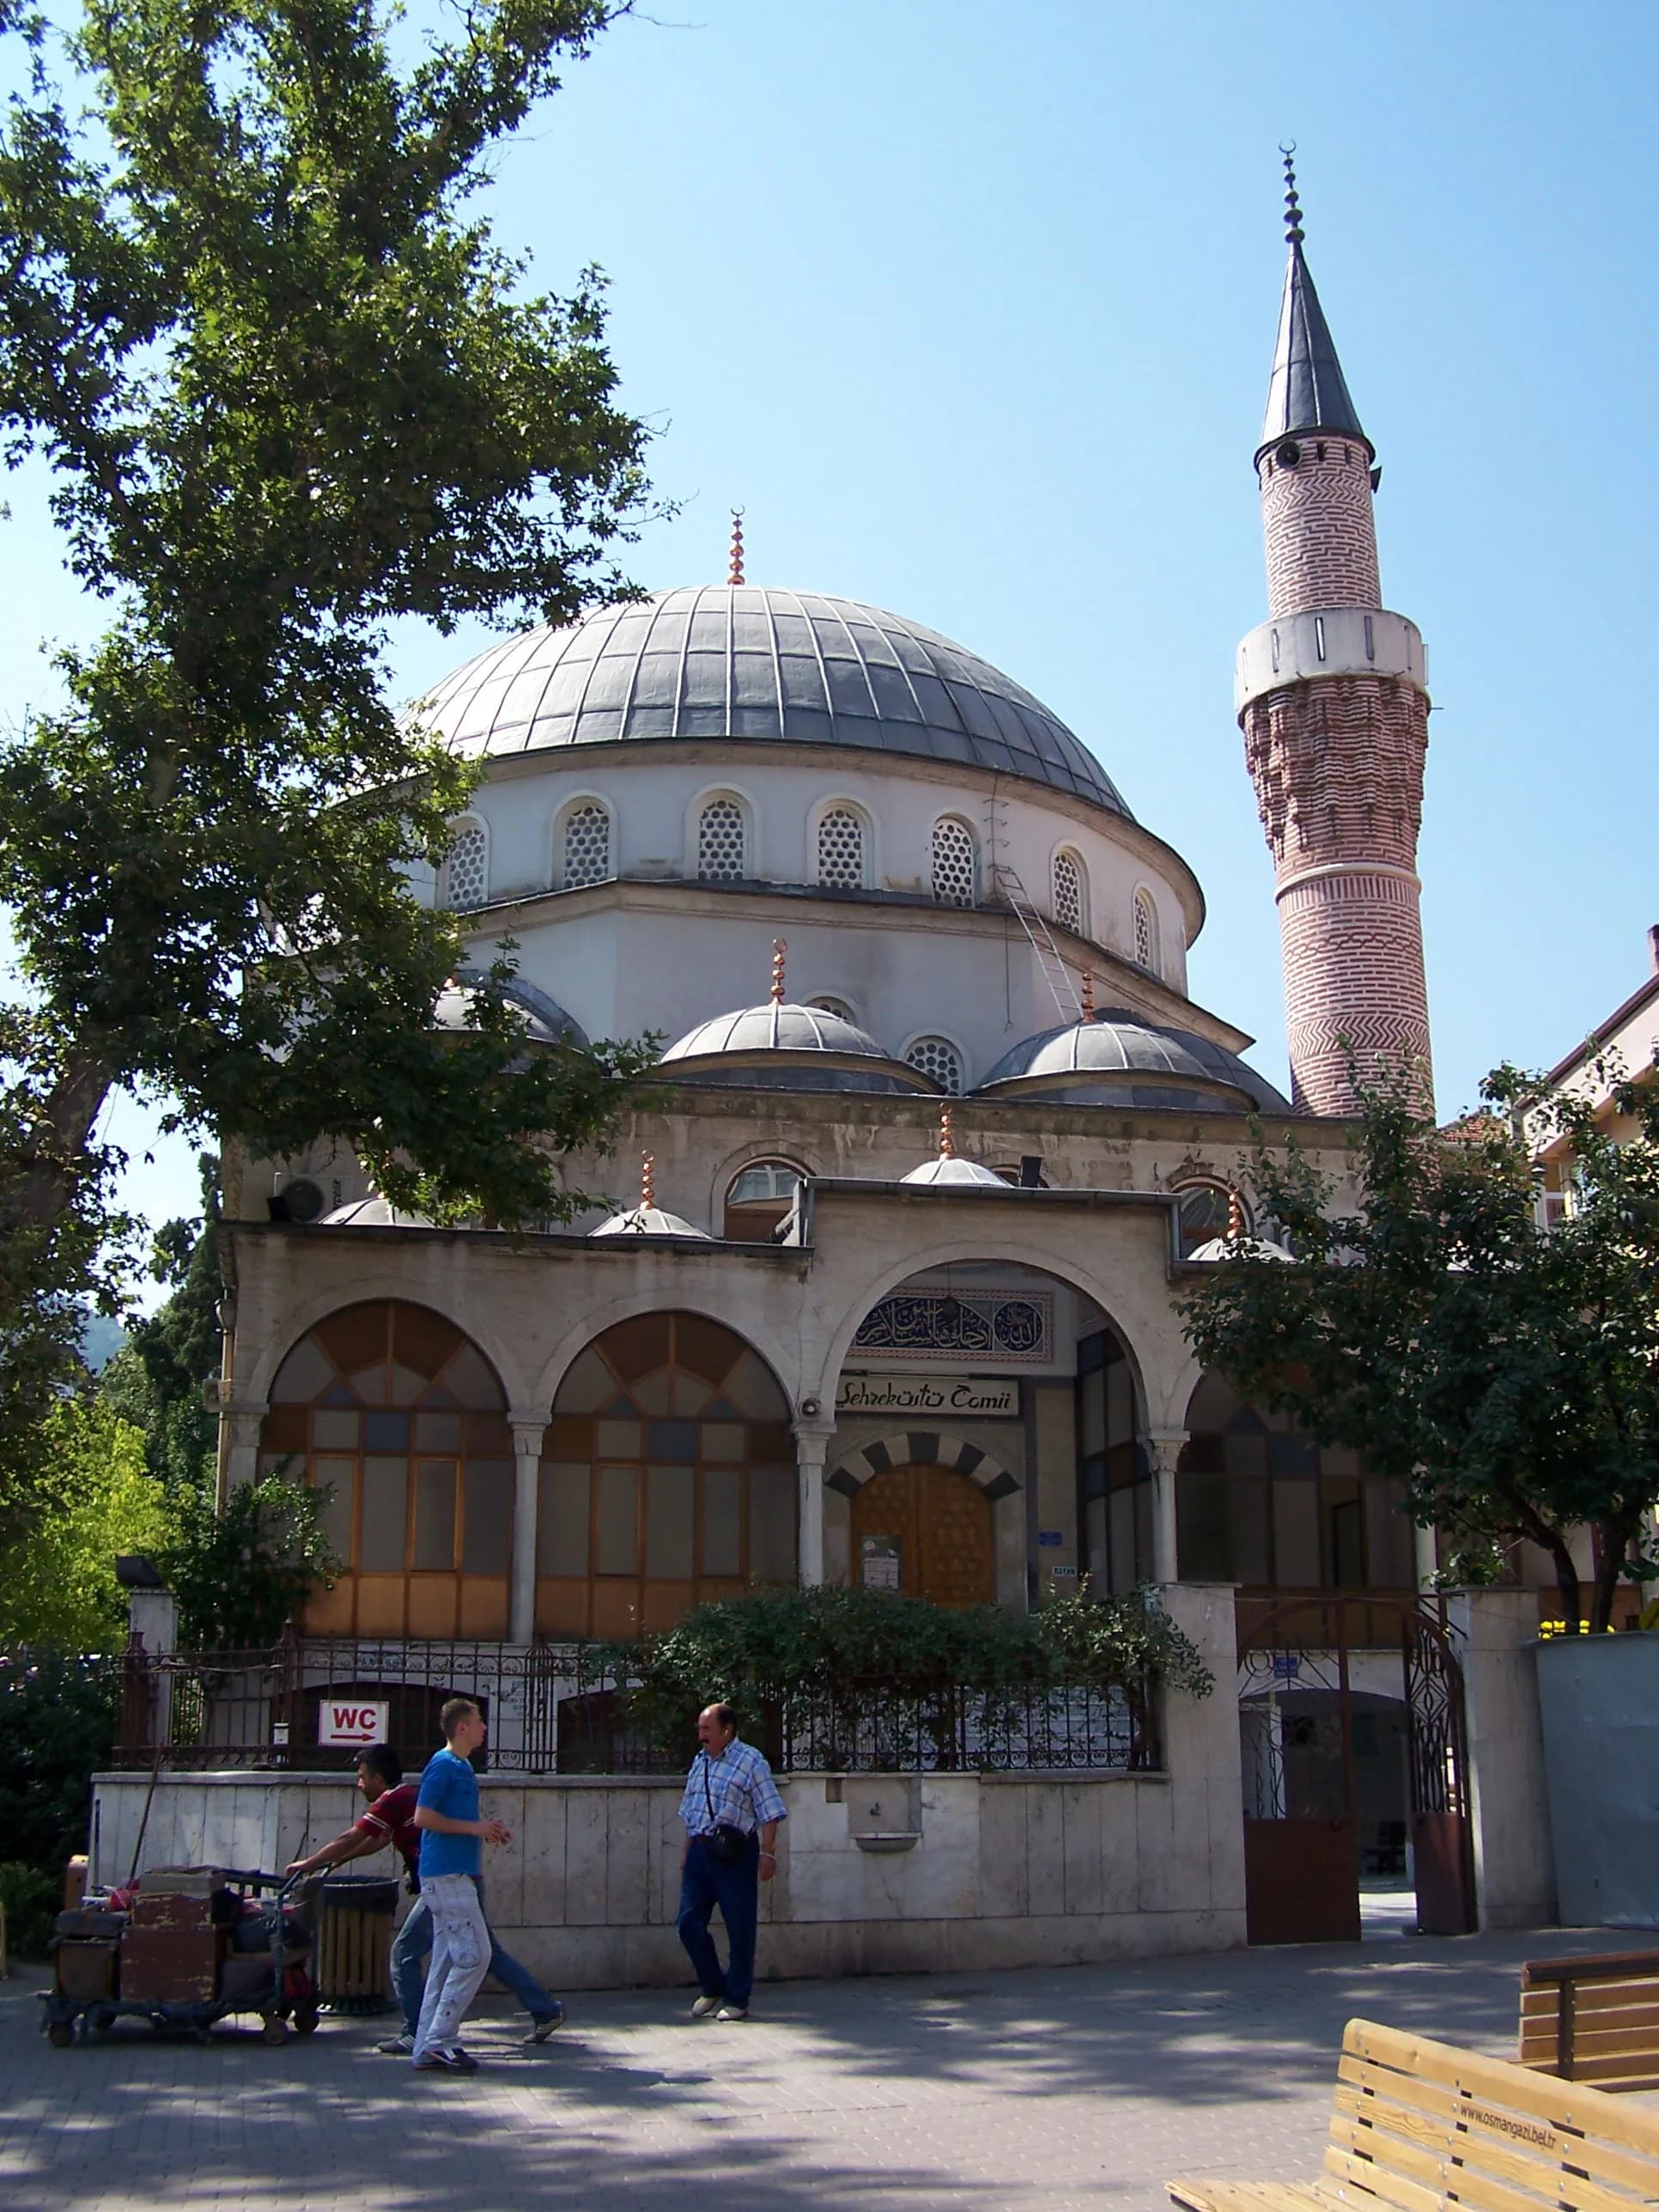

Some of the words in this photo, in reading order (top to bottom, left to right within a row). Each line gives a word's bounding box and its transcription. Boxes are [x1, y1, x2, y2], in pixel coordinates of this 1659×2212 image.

[951, 1384, 1010, 1409] Camii
[333, 1708, 377, 1729] WC
[1461, 2105, 1557, 2149] www.osmangazi.bel.tr
